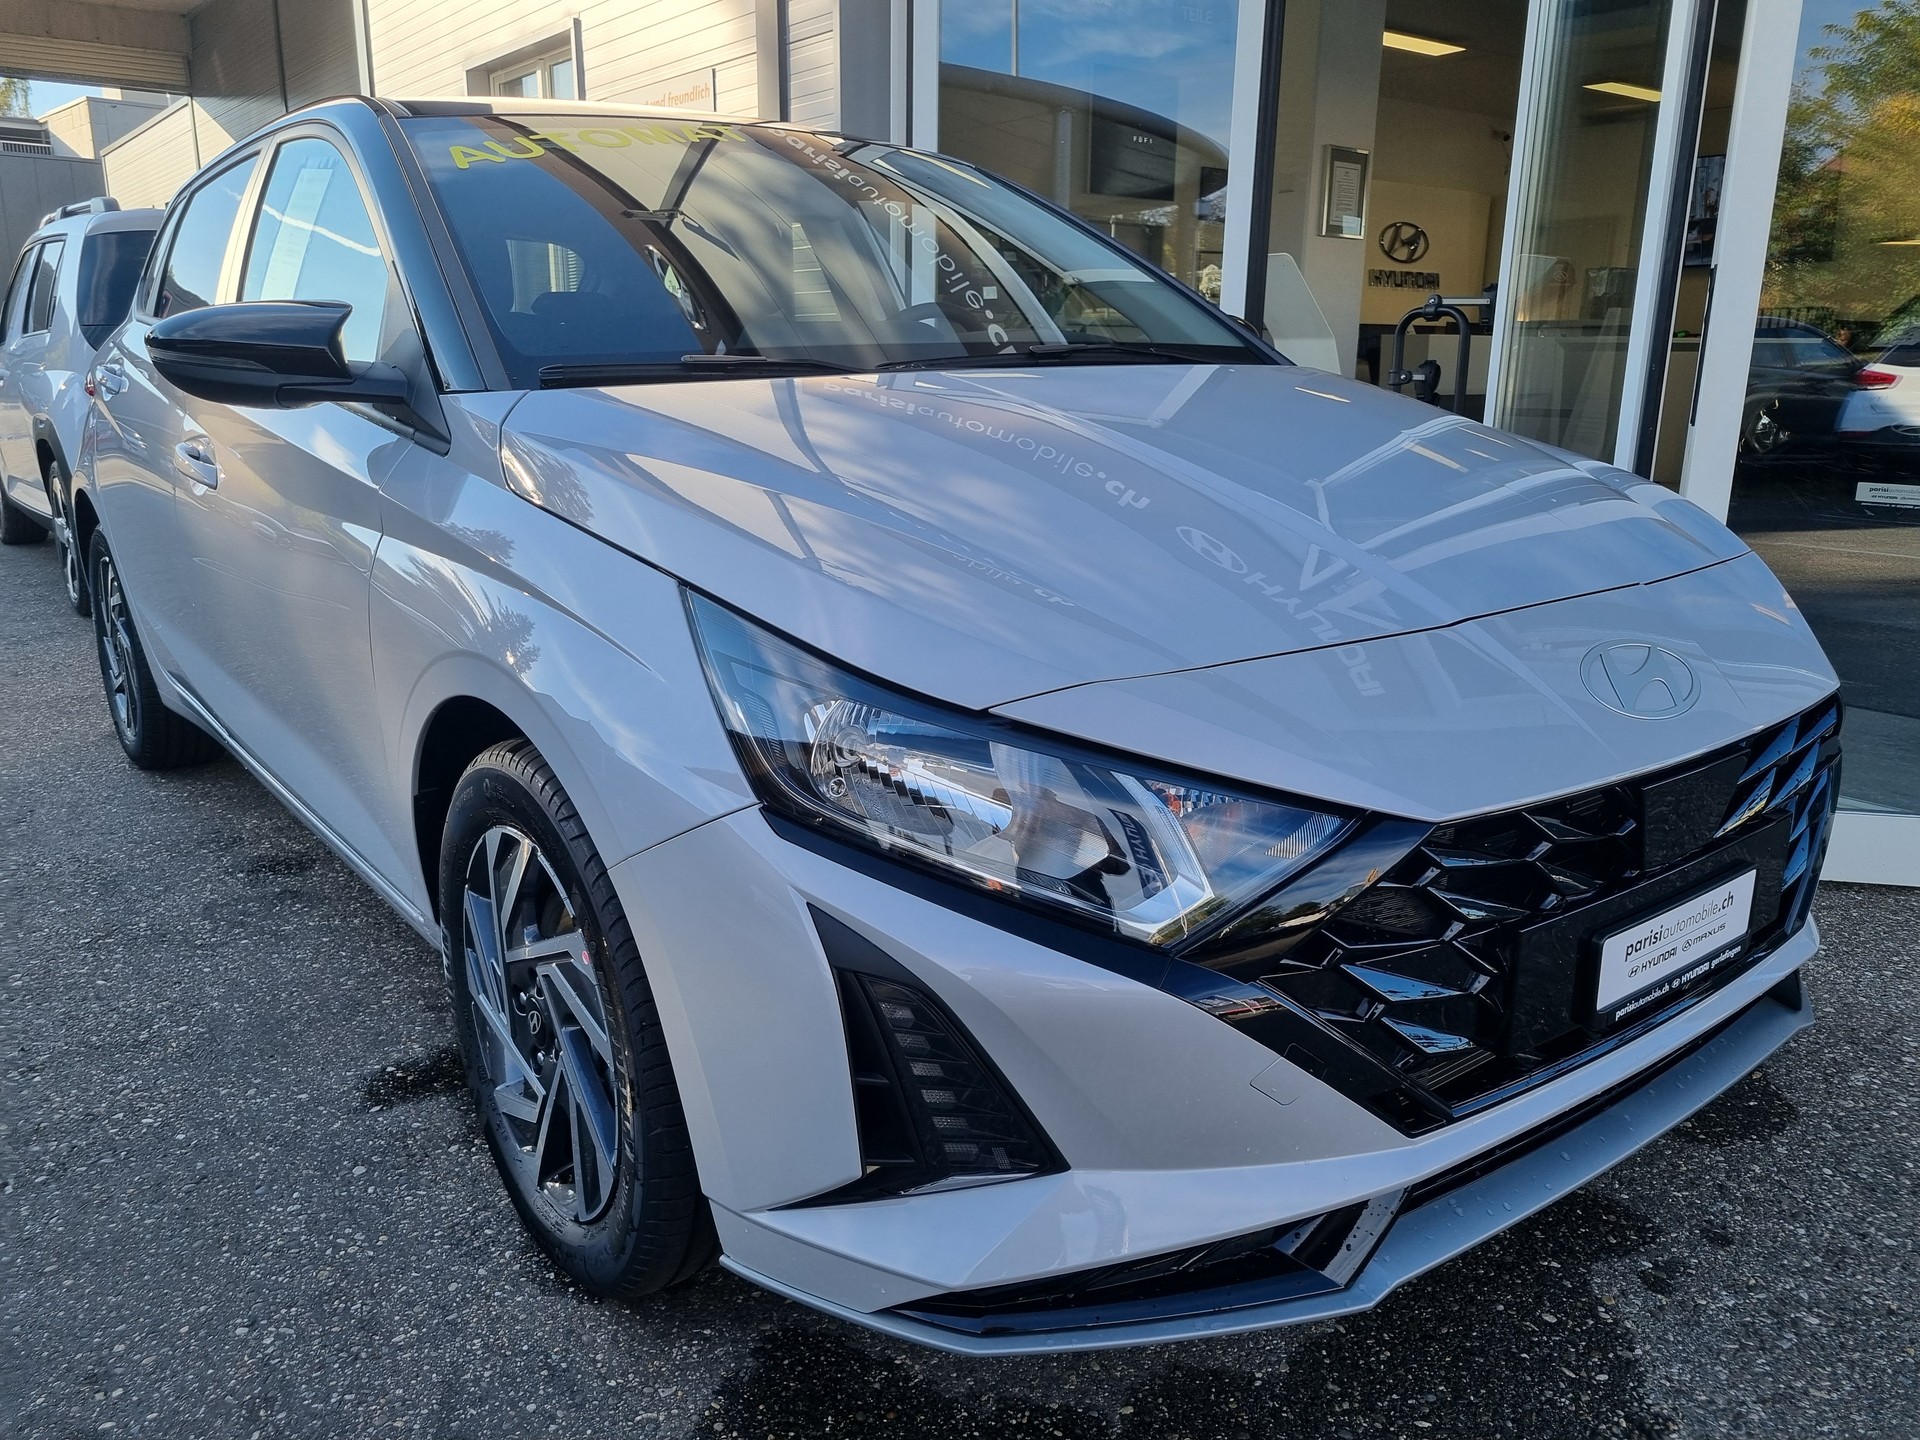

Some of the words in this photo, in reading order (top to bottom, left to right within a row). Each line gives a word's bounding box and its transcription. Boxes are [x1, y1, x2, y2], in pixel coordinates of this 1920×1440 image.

[667, 83, 711, 107] freundlich
[449, 124, 747, 170] AUTOMAT
[1368, 268, 1440, 290] HYUNDAI
[1624, 891, 1735, 962] parisiautomobile.ch
[1640, 946, 1678, 973] HYUNDAI
[1693, 923, 1726, 944] MAXUS
[1615, 982, 1670, 1022] parisiautomobile.ch
[1681, 961, 1710, 984] HYUNDAI
